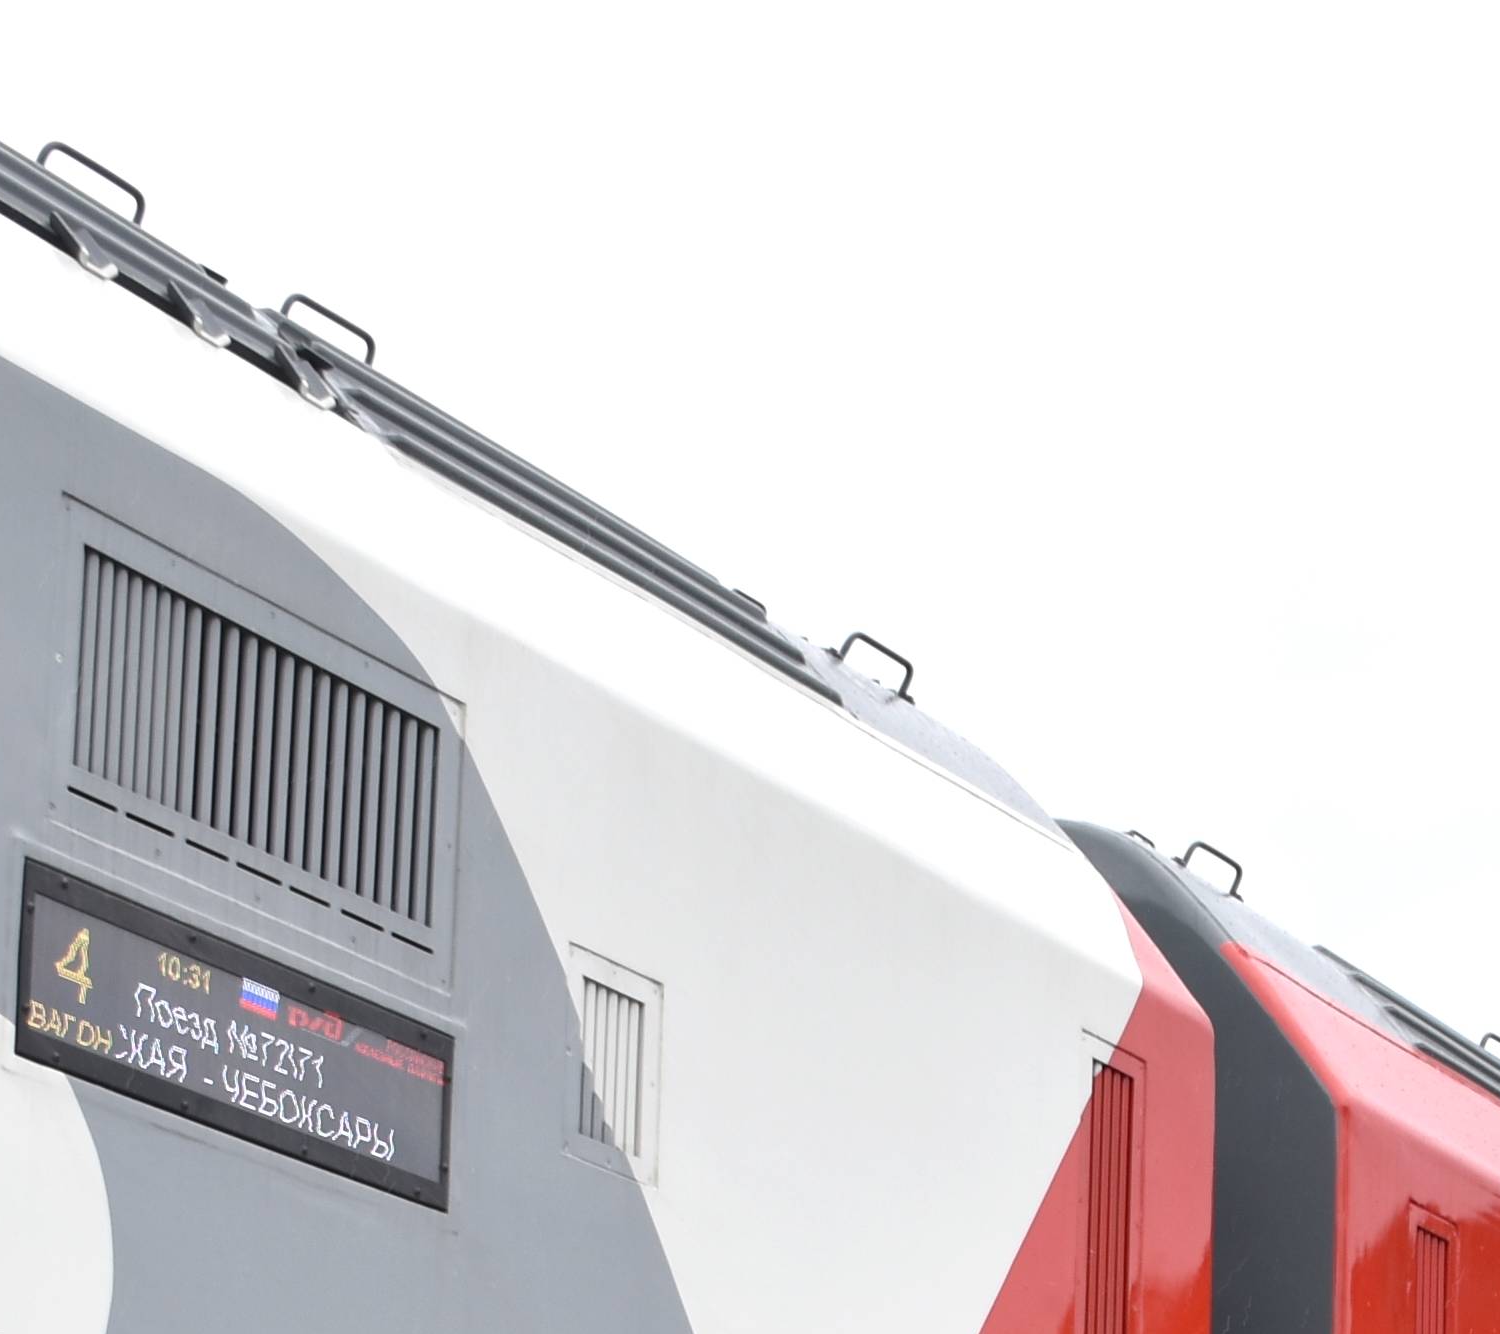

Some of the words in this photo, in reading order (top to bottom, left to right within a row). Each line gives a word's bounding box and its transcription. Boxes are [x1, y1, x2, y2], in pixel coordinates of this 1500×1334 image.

[55, 927, 93, 1005] 4
[157, 951, 211, 995] 10:31
[27, 999, 113, 1054] ВАГОН
[134, 982, 220, 1055] Поезд
[222, 1064, 396, 1162] ЧЕБОКСАРЫ
